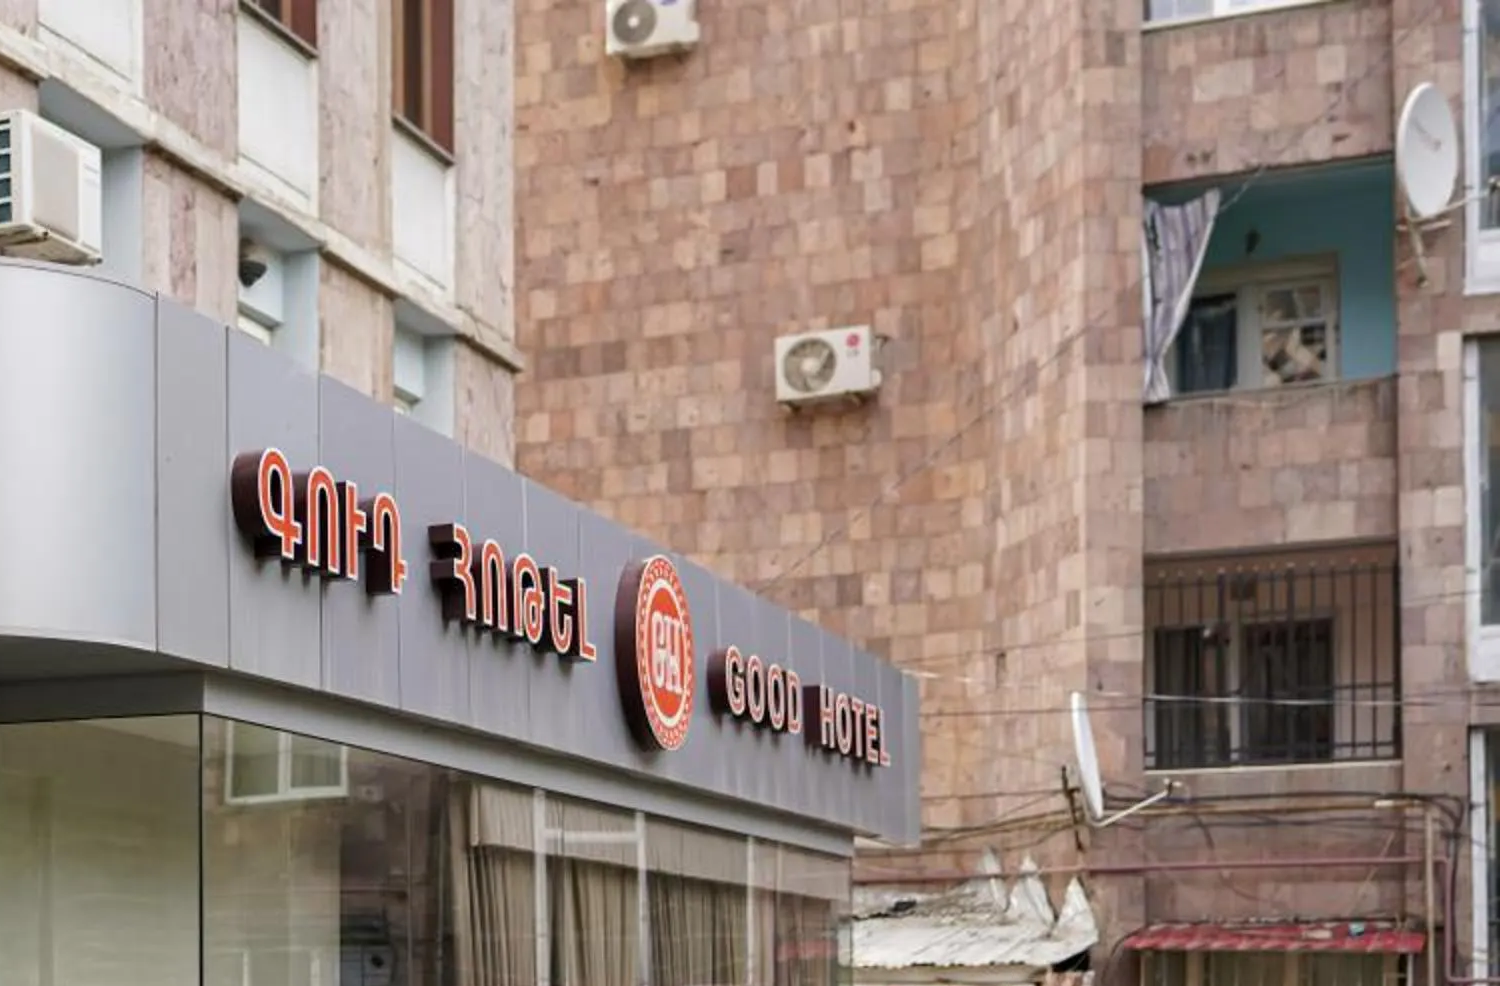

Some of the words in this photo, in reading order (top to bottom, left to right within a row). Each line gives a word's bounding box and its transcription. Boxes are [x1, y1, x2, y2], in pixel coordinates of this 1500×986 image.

[258, 447, 408, 595] ԳՈՒԴ
[453, 522, 596, 662] ՀՈԹԵԼ
[725, 644, 801, 734] GOOD
[820, 684, 891, 767] HOTEL
